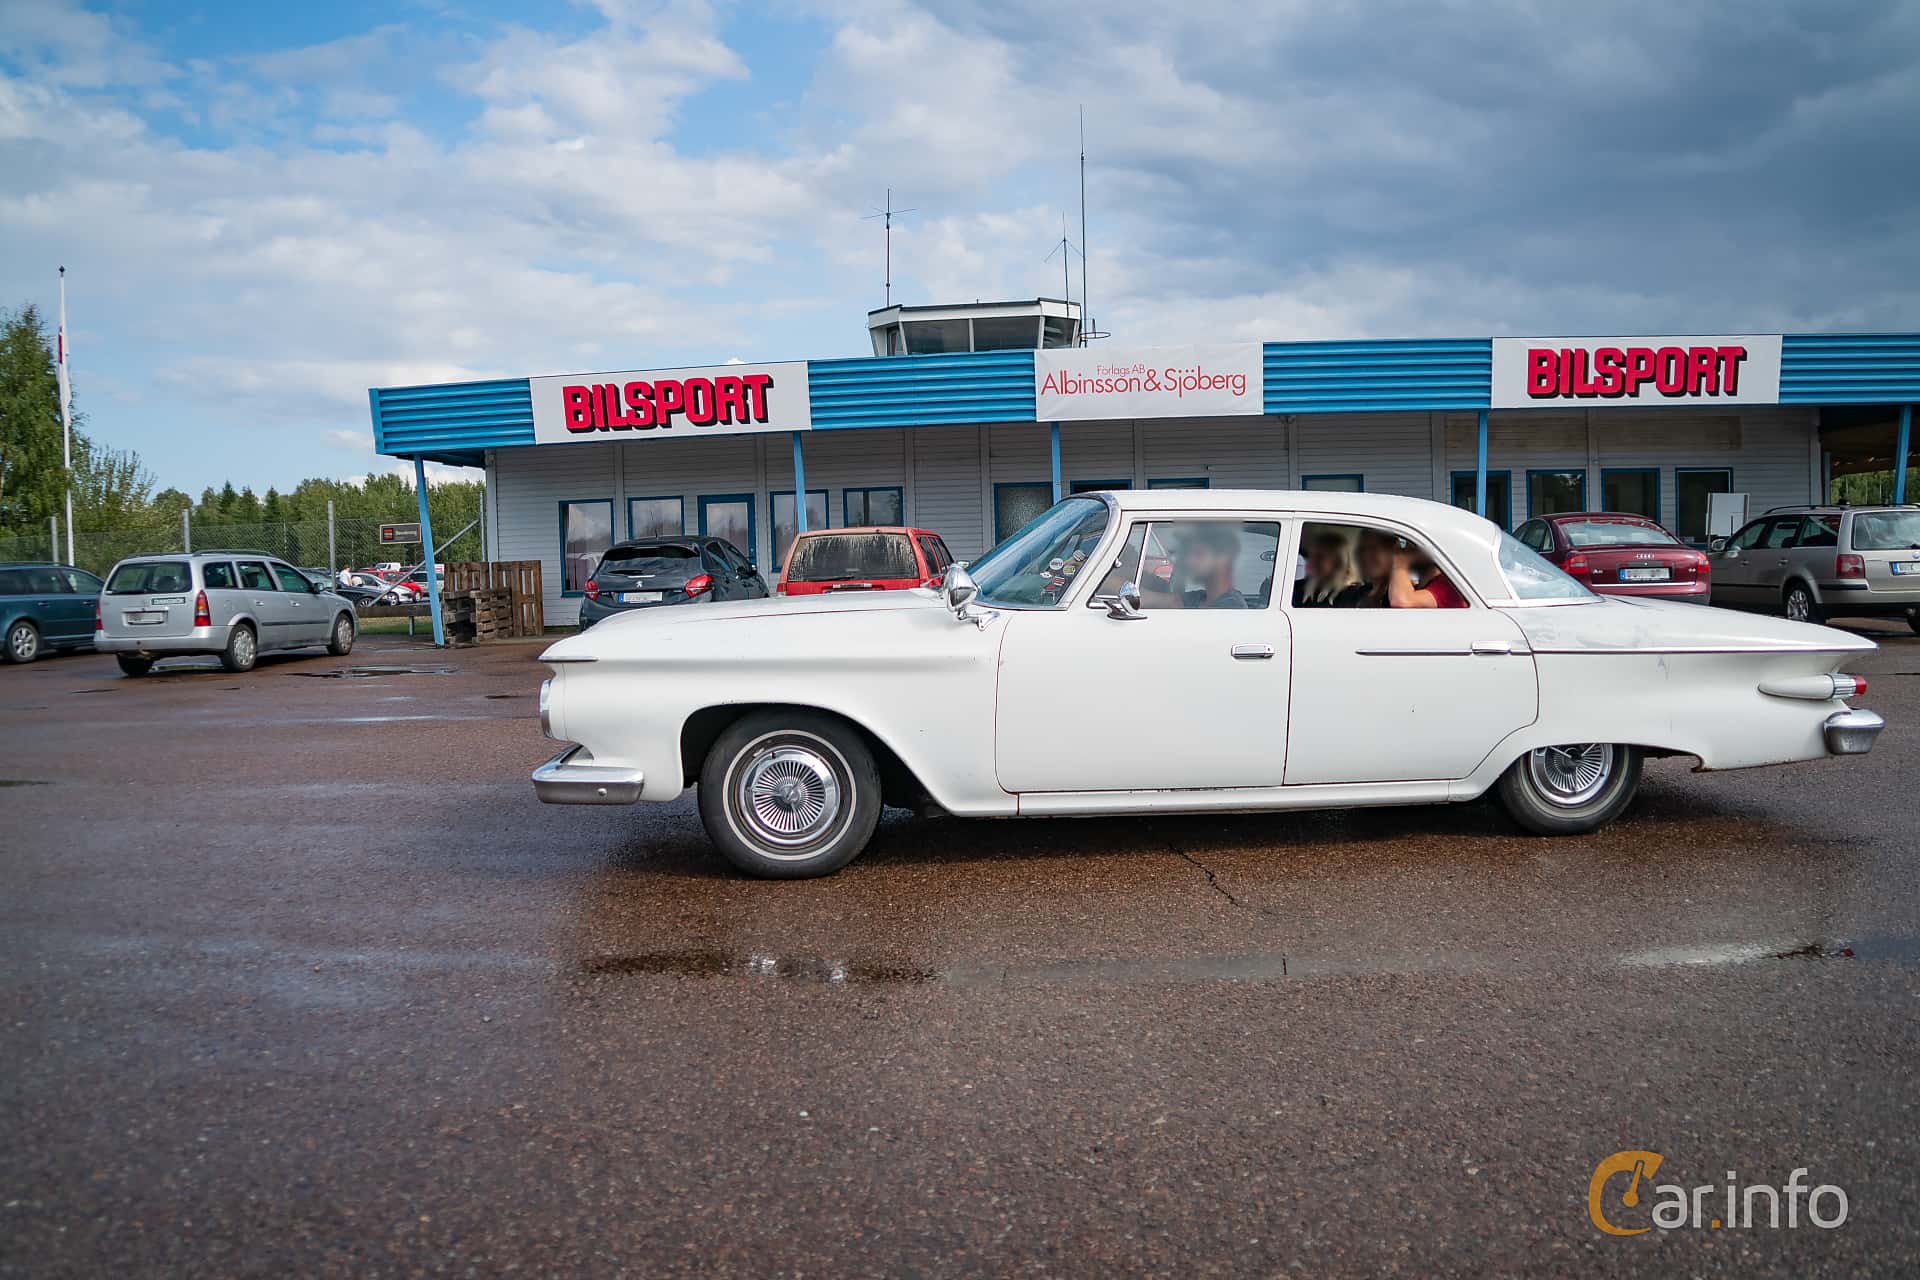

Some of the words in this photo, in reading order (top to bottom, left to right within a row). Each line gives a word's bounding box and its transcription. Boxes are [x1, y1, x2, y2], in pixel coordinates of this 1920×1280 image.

[1041, 369, 1141, 396] Albinsson
[1143, 368, 1162, 392] &
[1164, 365, 1247, 398] Sjöberg
[1132, 363, 1146, 374] AB
[1527, 346, 1748, 398] BILSPORT
[563, 374, 774, 433] BILSPORT
